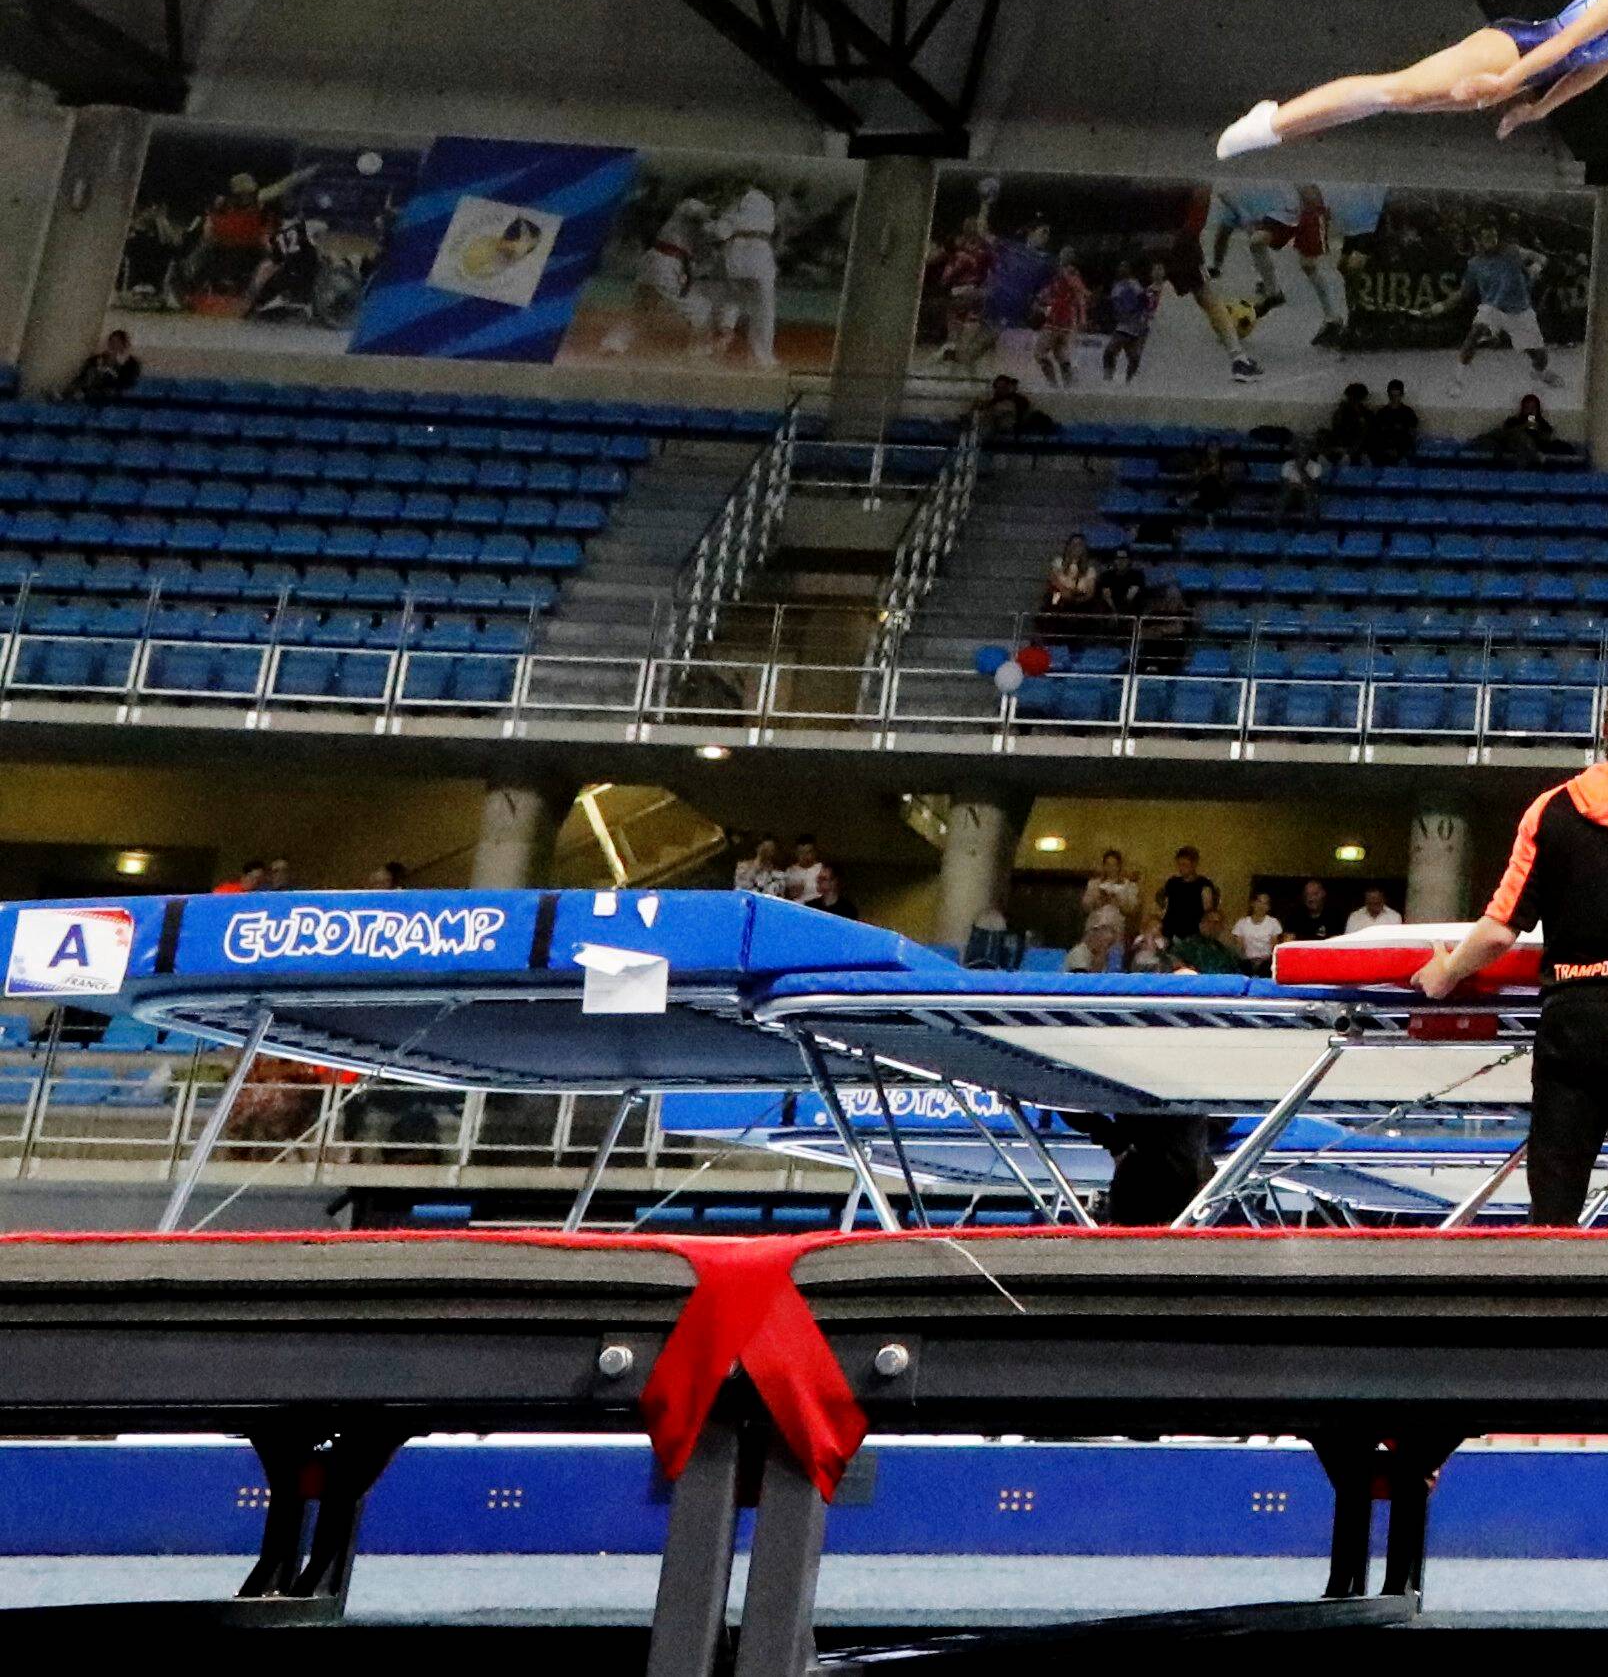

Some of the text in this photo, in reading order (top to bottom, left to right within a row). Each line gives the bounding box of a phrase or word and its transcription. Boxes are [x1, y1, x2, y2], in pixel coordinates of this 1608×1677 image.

[277, 229, 302, 255] 12
[48, 923, 90, 969] A
[224, 907, 506, 964] EUROTRAMP
